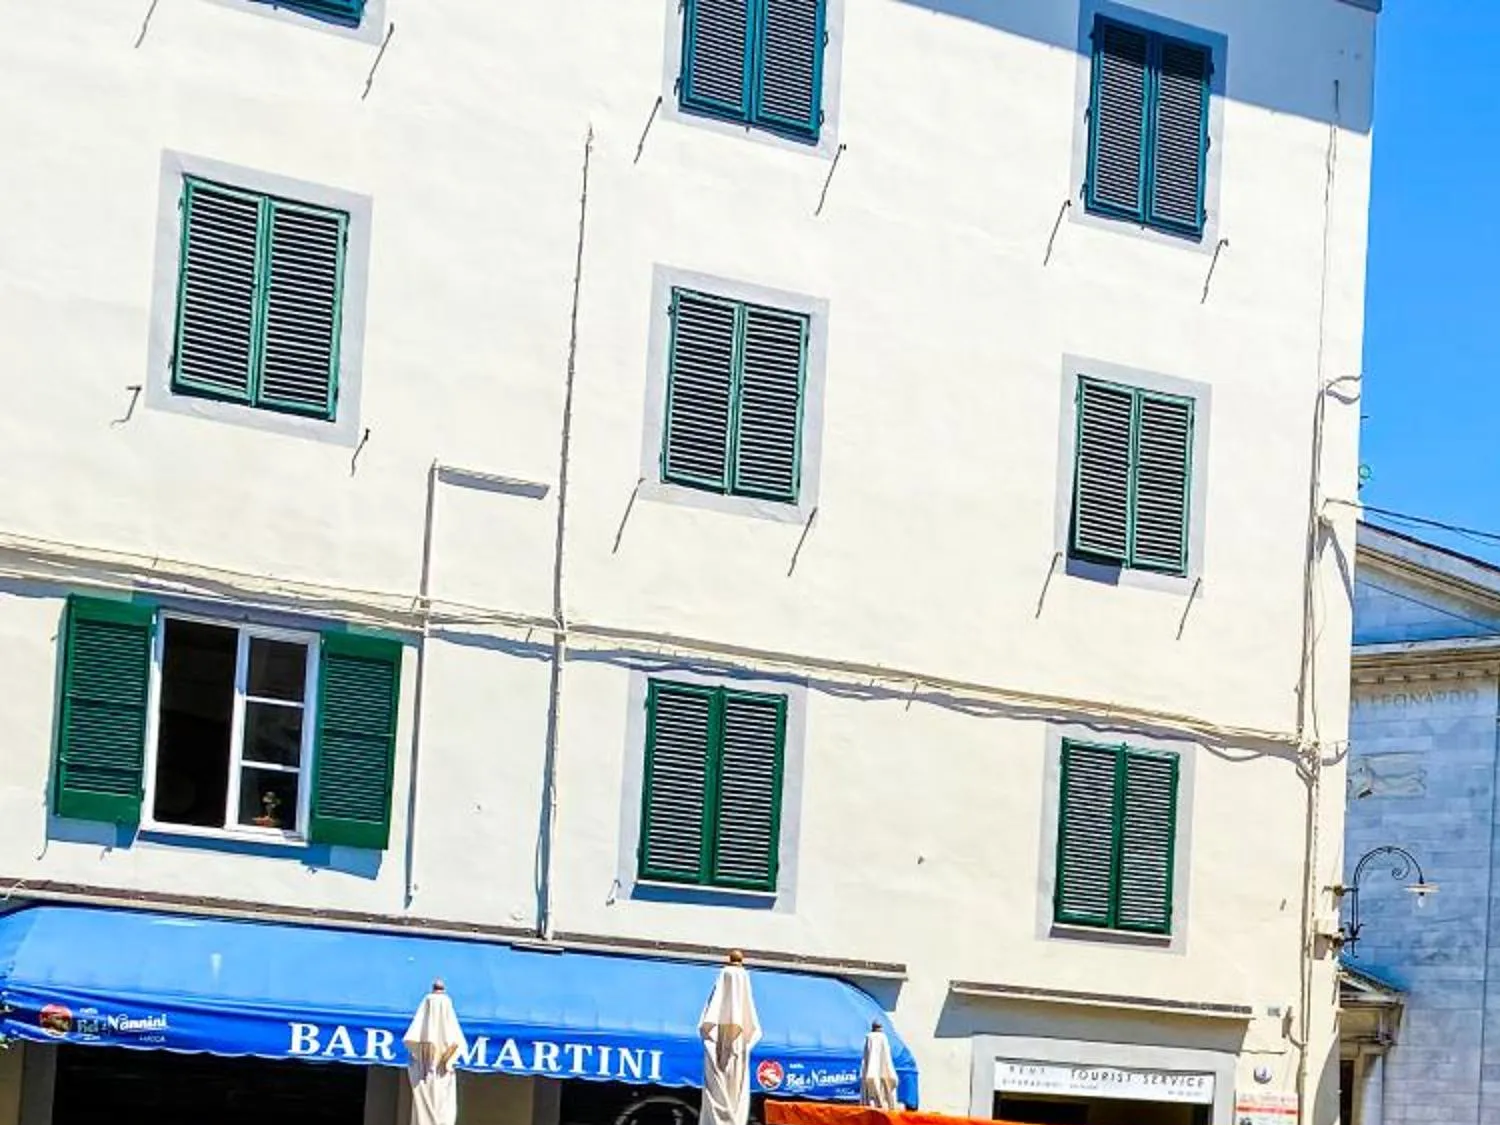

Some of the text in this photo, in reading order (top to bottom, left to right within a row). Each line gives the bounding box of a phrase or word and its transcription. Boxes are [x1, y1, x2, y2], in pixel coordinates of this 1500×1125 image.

[107, 1013, 167, 1031] Nannini
[287, 1022, 664, 1081] BAR MARTINI
[1070, 1069, 1132, 1083] TOURIST
[1143, 1073, 1205, 1088] SERVICE
